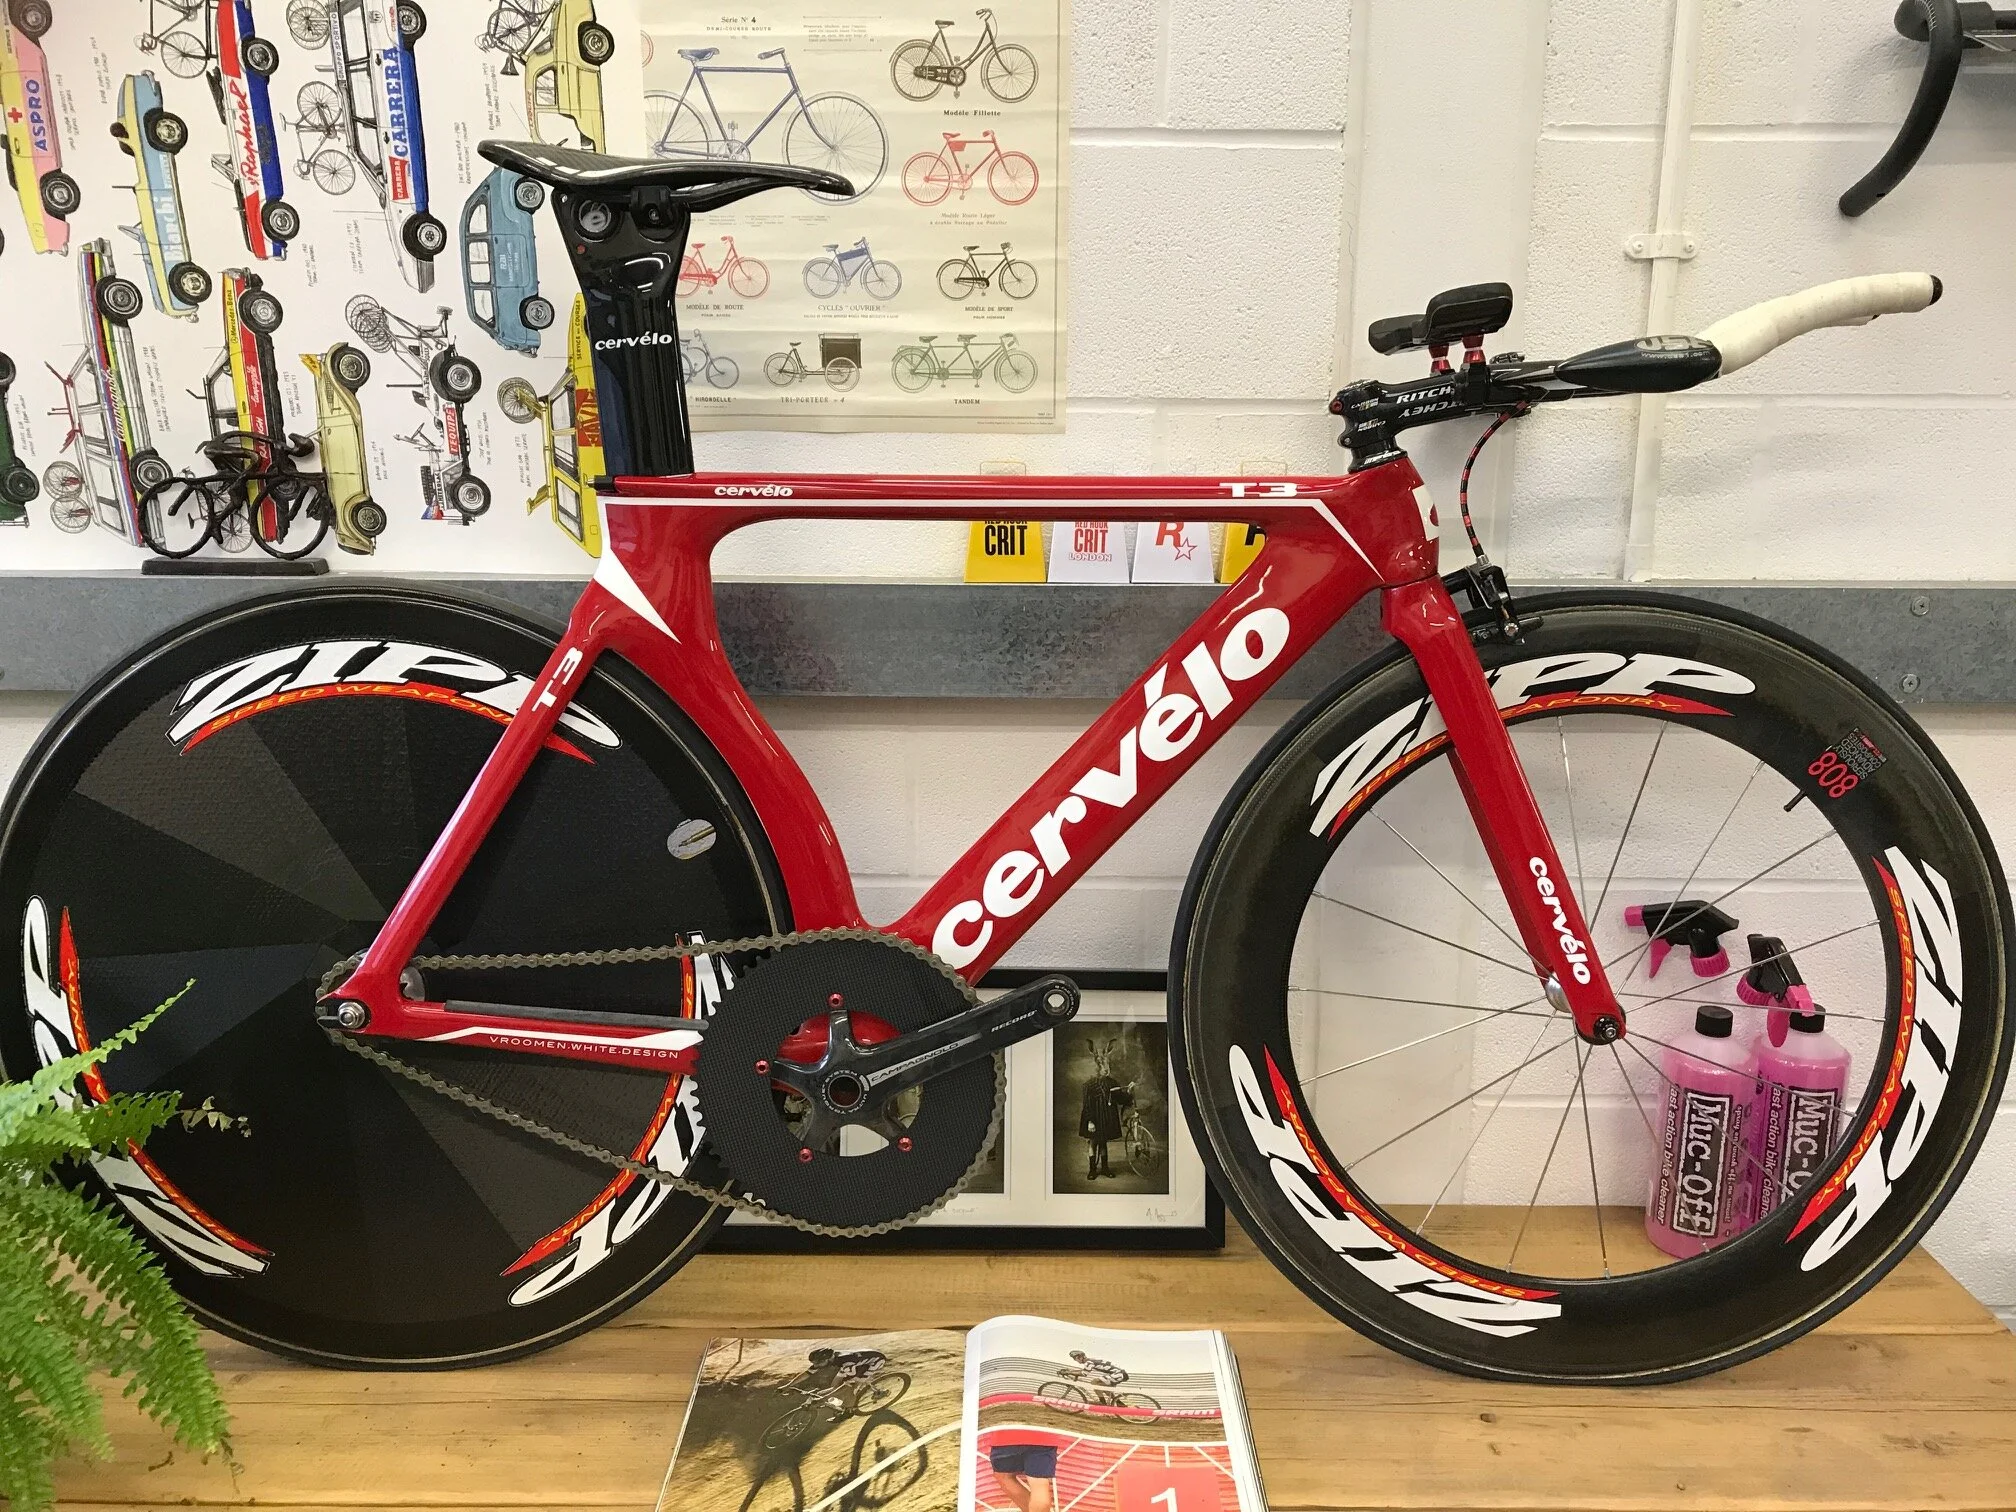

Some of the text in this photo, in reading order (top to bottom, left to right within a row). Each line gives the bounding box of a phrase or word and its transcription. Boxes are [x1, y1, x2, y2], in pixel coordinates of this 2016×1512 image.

[750, 16, 757, 24] 4
[329, 12, 346, 79] GRUPPO SPORTIVO
[26, 76, 49, 152] ASPRO
[382, 46, 408, 158] CARRERA
[943, 109, 1001, 117] Modèle Fillette
[392, 158, 405, 200] CARRERA
[153, 194, 184, 262] Bianchi
[225, 289, 238, 337] Mercedes-Benz
[574, 300, 583, 327] COURSES
[817, 304, 844, 312] CYCLES
[575, 336, 584, 360] SERVICE
[594, 331, 673, 351] cervélo
[101, 367, 127, 443] Campagnolo
[444, 407, 459, 453] L'EQUIPE
[714, 484, 794, 497] cervélo
[1218, 482, 1298, 498] T3
[984, 525, 1028, 556] CRIT
[1073, 529, 1109, 554] CRIT
[1155, 521, 1185, 547] R
[1068, 552, 1113, 563] LONDON
[531, 647, 583, 713] T3
[209, 682, 515, 731] SPEED WEAPON
[1833, 745, 1868, 780] SERIOUSLY
[1841, 738, 1876, 773] ADVANCED
[1848, 732, 1883, 768] COMPOSITES
[933, 607, 1293, 970] cervélo
[1345, 734, 1448, 814] SPEED
[1808, 752, 1858, 798] 808
[1529, 856, 1592, 986] cervélo
[990, 1009, 1038, 1033] RECORD
[489, 1036, 680, 1059] VROOMEN.WHITE.DESIGN
[871, 1042, 960, 1083] CAMPAGNOLO
[1800, 846, 1962, 1272] ZIPP
[1815, 886, 1915, 1206] SPEED WEAPONRY
[1663, 1110, 1677, 1148] action
[1767, 1110, 1780, 1147] action
[1788, 1097, 1828, 1190] Muc-O
[1660, 1149, 1674, 1176] bike
[1678, 1100, 1722, 1231] Muc-Off
[1729, 1145, 1739, 1167] wash
[1227, 1043, 1561, 1339] ZIPP
[1279, 1089, 1526, 1298] SPEED WEAPONRY
[1656, 1177, 1670, 1224] cleaner
[1031, 1395, 1092, 1410] SRAM
[1151, 1408, 1216, 1417] SRAM
[1150, 1487, 1179, 1512] 1
